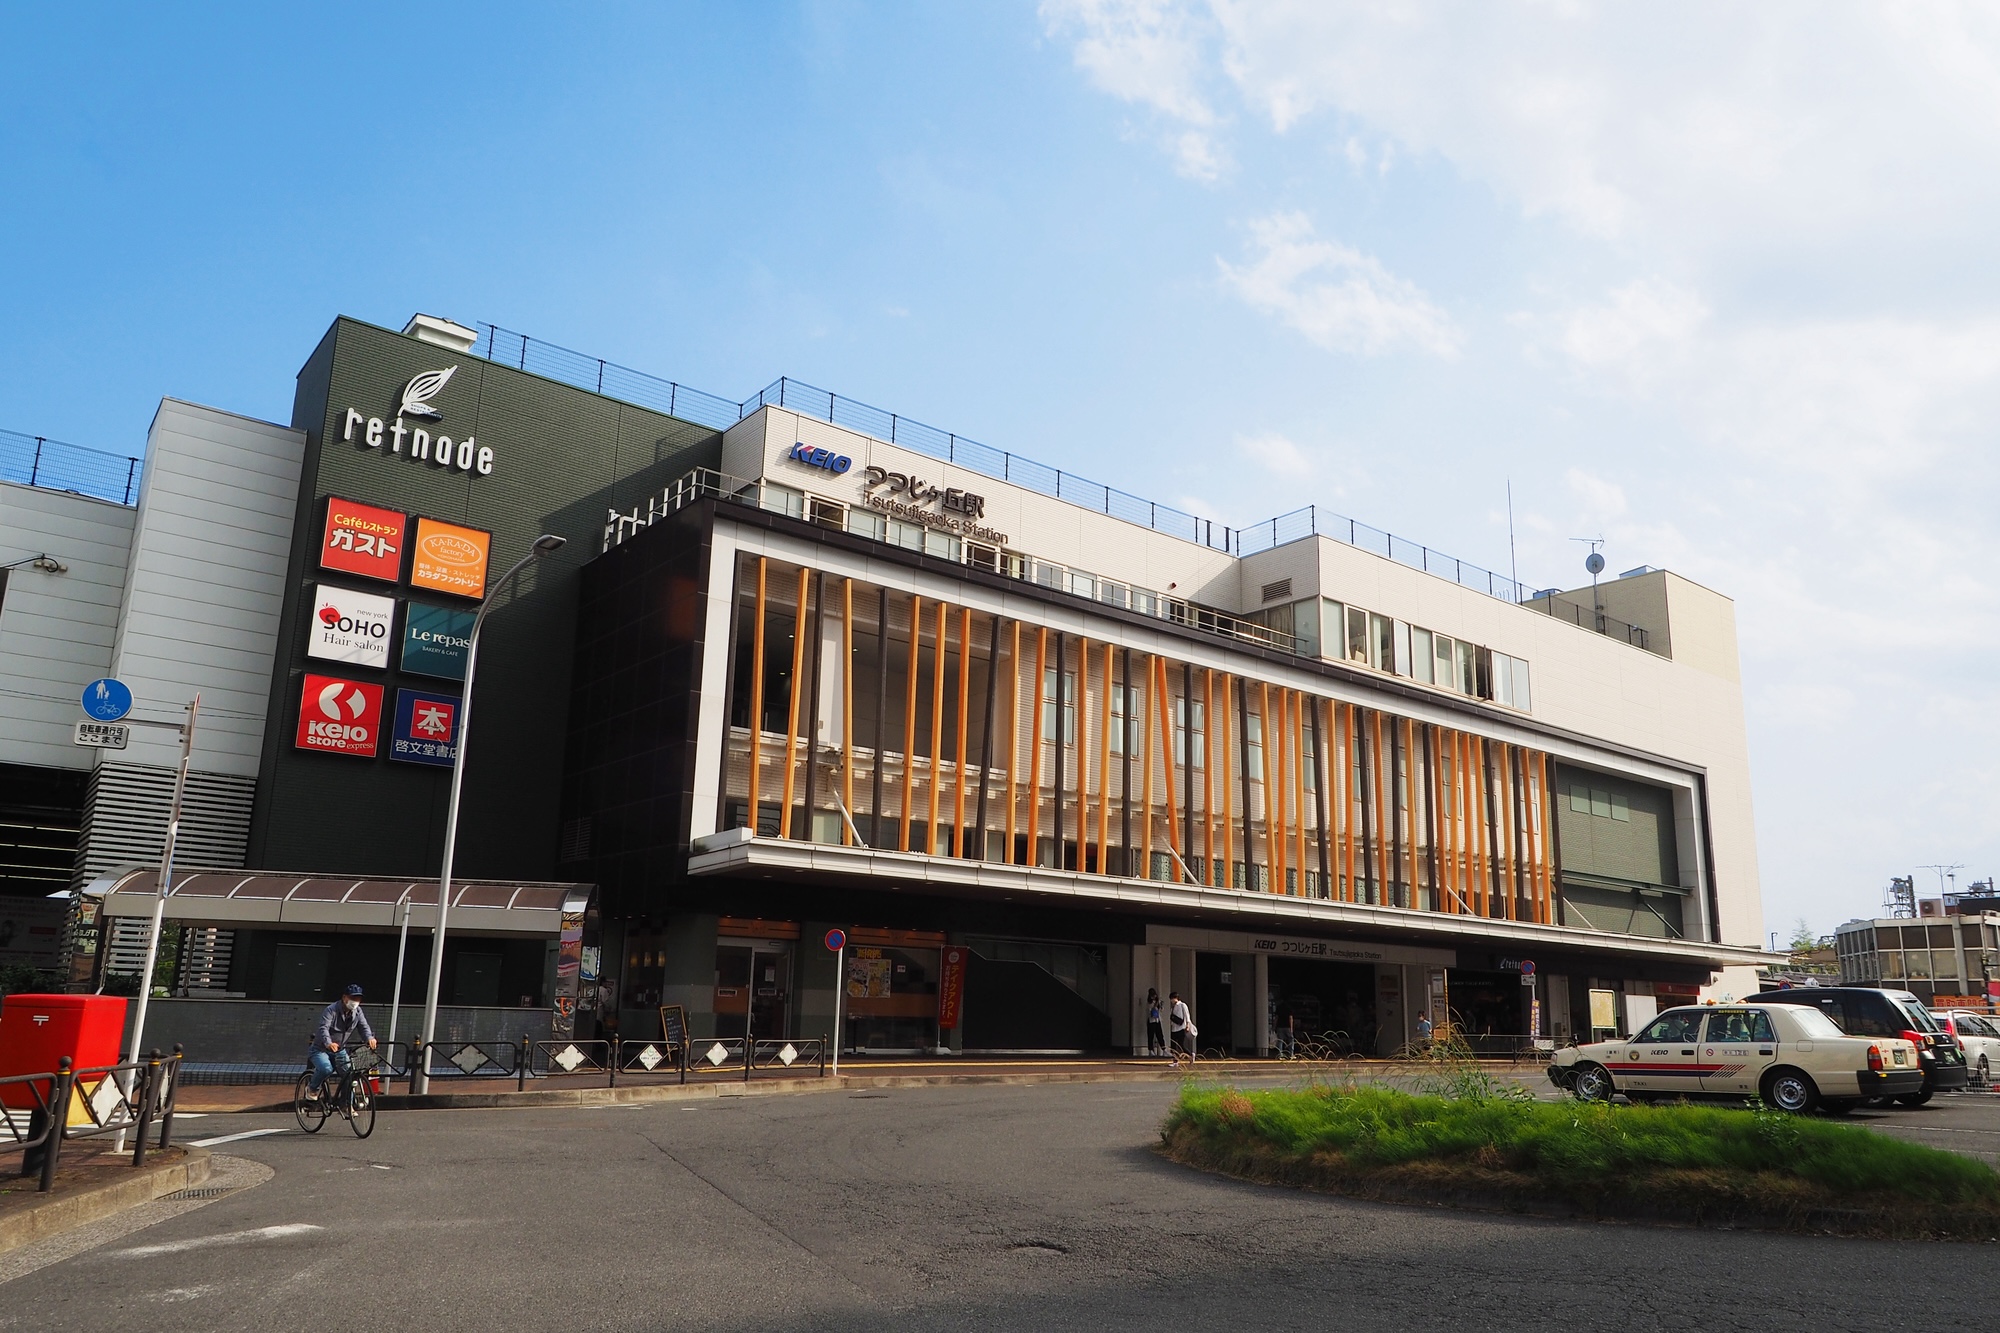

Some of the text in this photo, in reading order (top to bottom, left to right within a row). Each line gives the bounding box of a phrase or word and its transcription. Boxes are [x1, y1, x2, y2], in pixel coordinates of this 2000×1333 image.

[789, 442, 852, 473] KEIO
[866, 465, 985, 519] つつじヶ丘駅
[865, 490, 1009, 544] Tsutsujigaoka Station
[330, 527, 397, 558] ガスト
[440, 546, 465, 558] factory
[417, 569, 480, 587] カラダファクトリー
[356, 608, 389, 620] new york
[323, 614, 386, 638] SOHO
[323, 632, 384, 653] Hair salon
[411, 628, 471, 649] Le repas
[422, 646, 441, 655] BAKERY
[80, 724, 124, 736] 自転車通行可
[417, 707, 447, 735] 本
[79, 734, 122, 744] ここまで
[306, 735, 374, 751] store express
[1254, 939, 1277, 950] KEIO
[1282, 941, 1327, 955] つつじヶ丘駅
[947, 965, 959, 1018] テイクアウト
